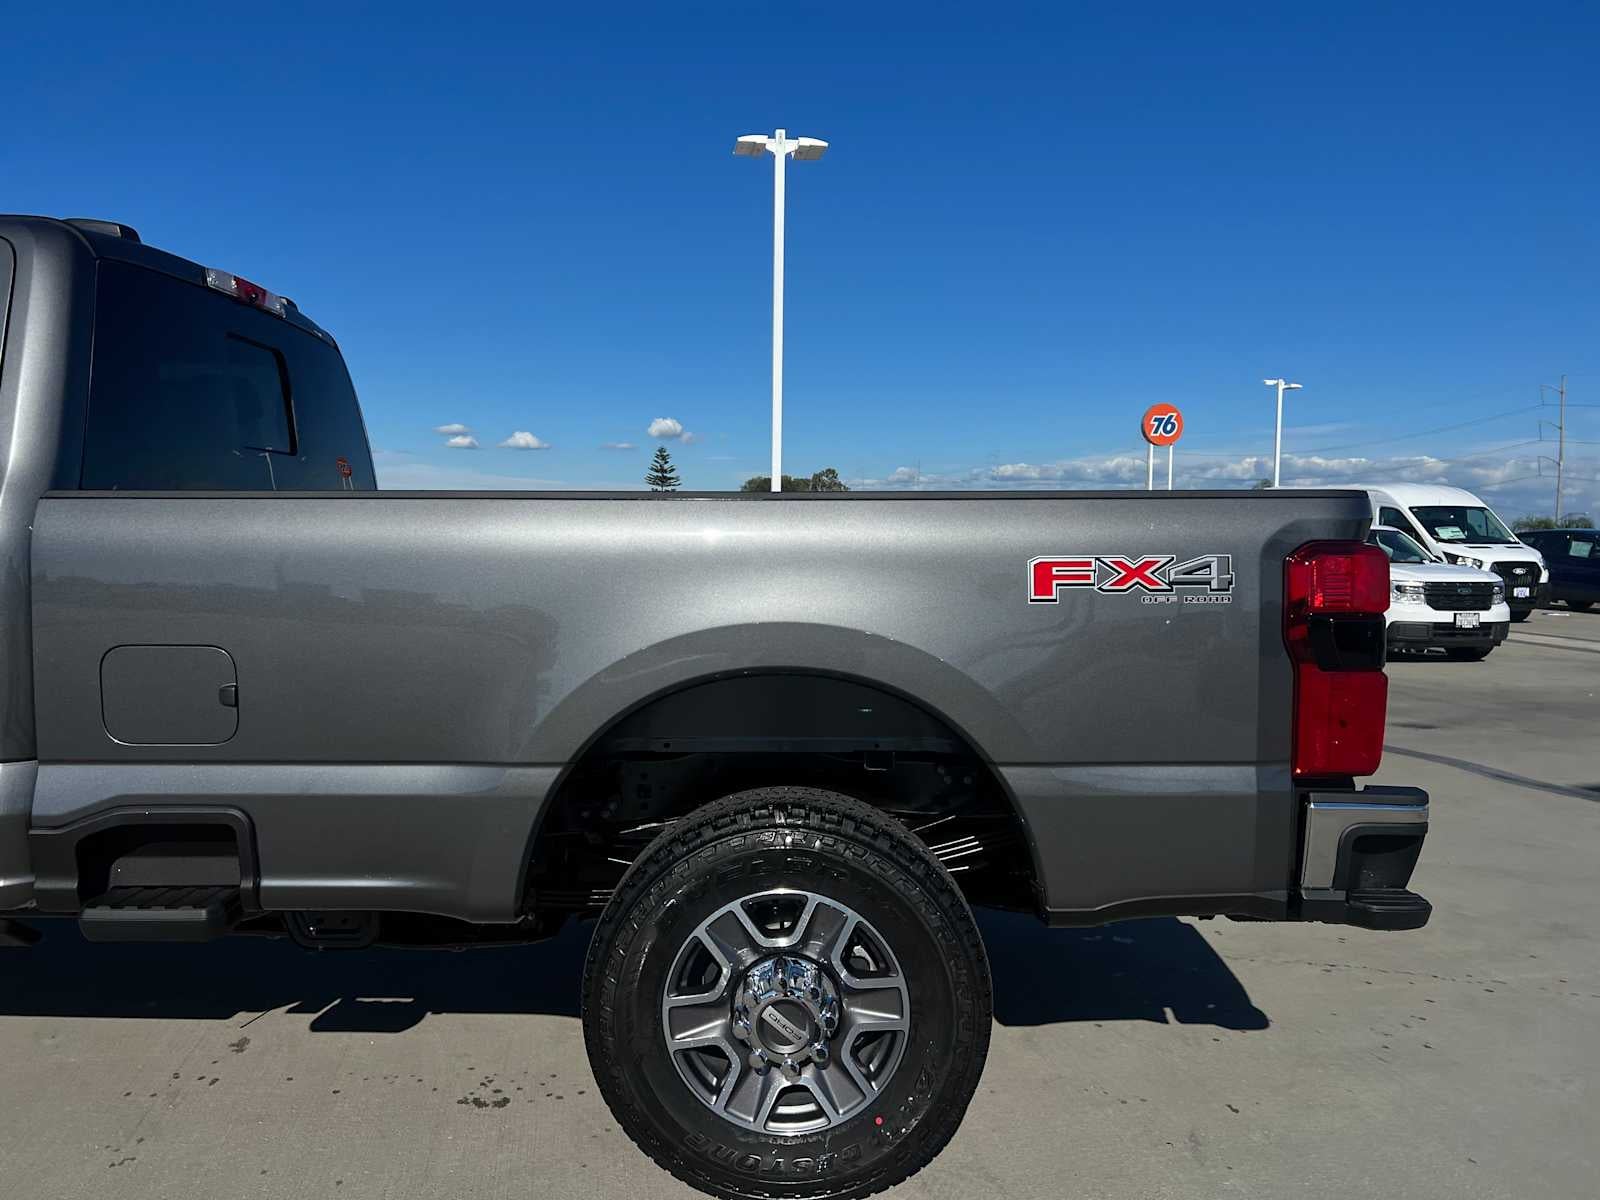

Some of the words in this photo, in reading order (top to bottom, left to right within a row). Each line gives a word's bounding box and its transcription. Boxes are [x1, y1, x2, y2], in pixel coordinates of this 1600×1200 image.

[1150, 412, 1178, 437] 76
[1028, 555, 1235, 604] FX4
[1141, 595, 1177, 604] OFF
[1184, 595, 1233, 604] ROAD
[768, 1012, 802, 1040] FORD
